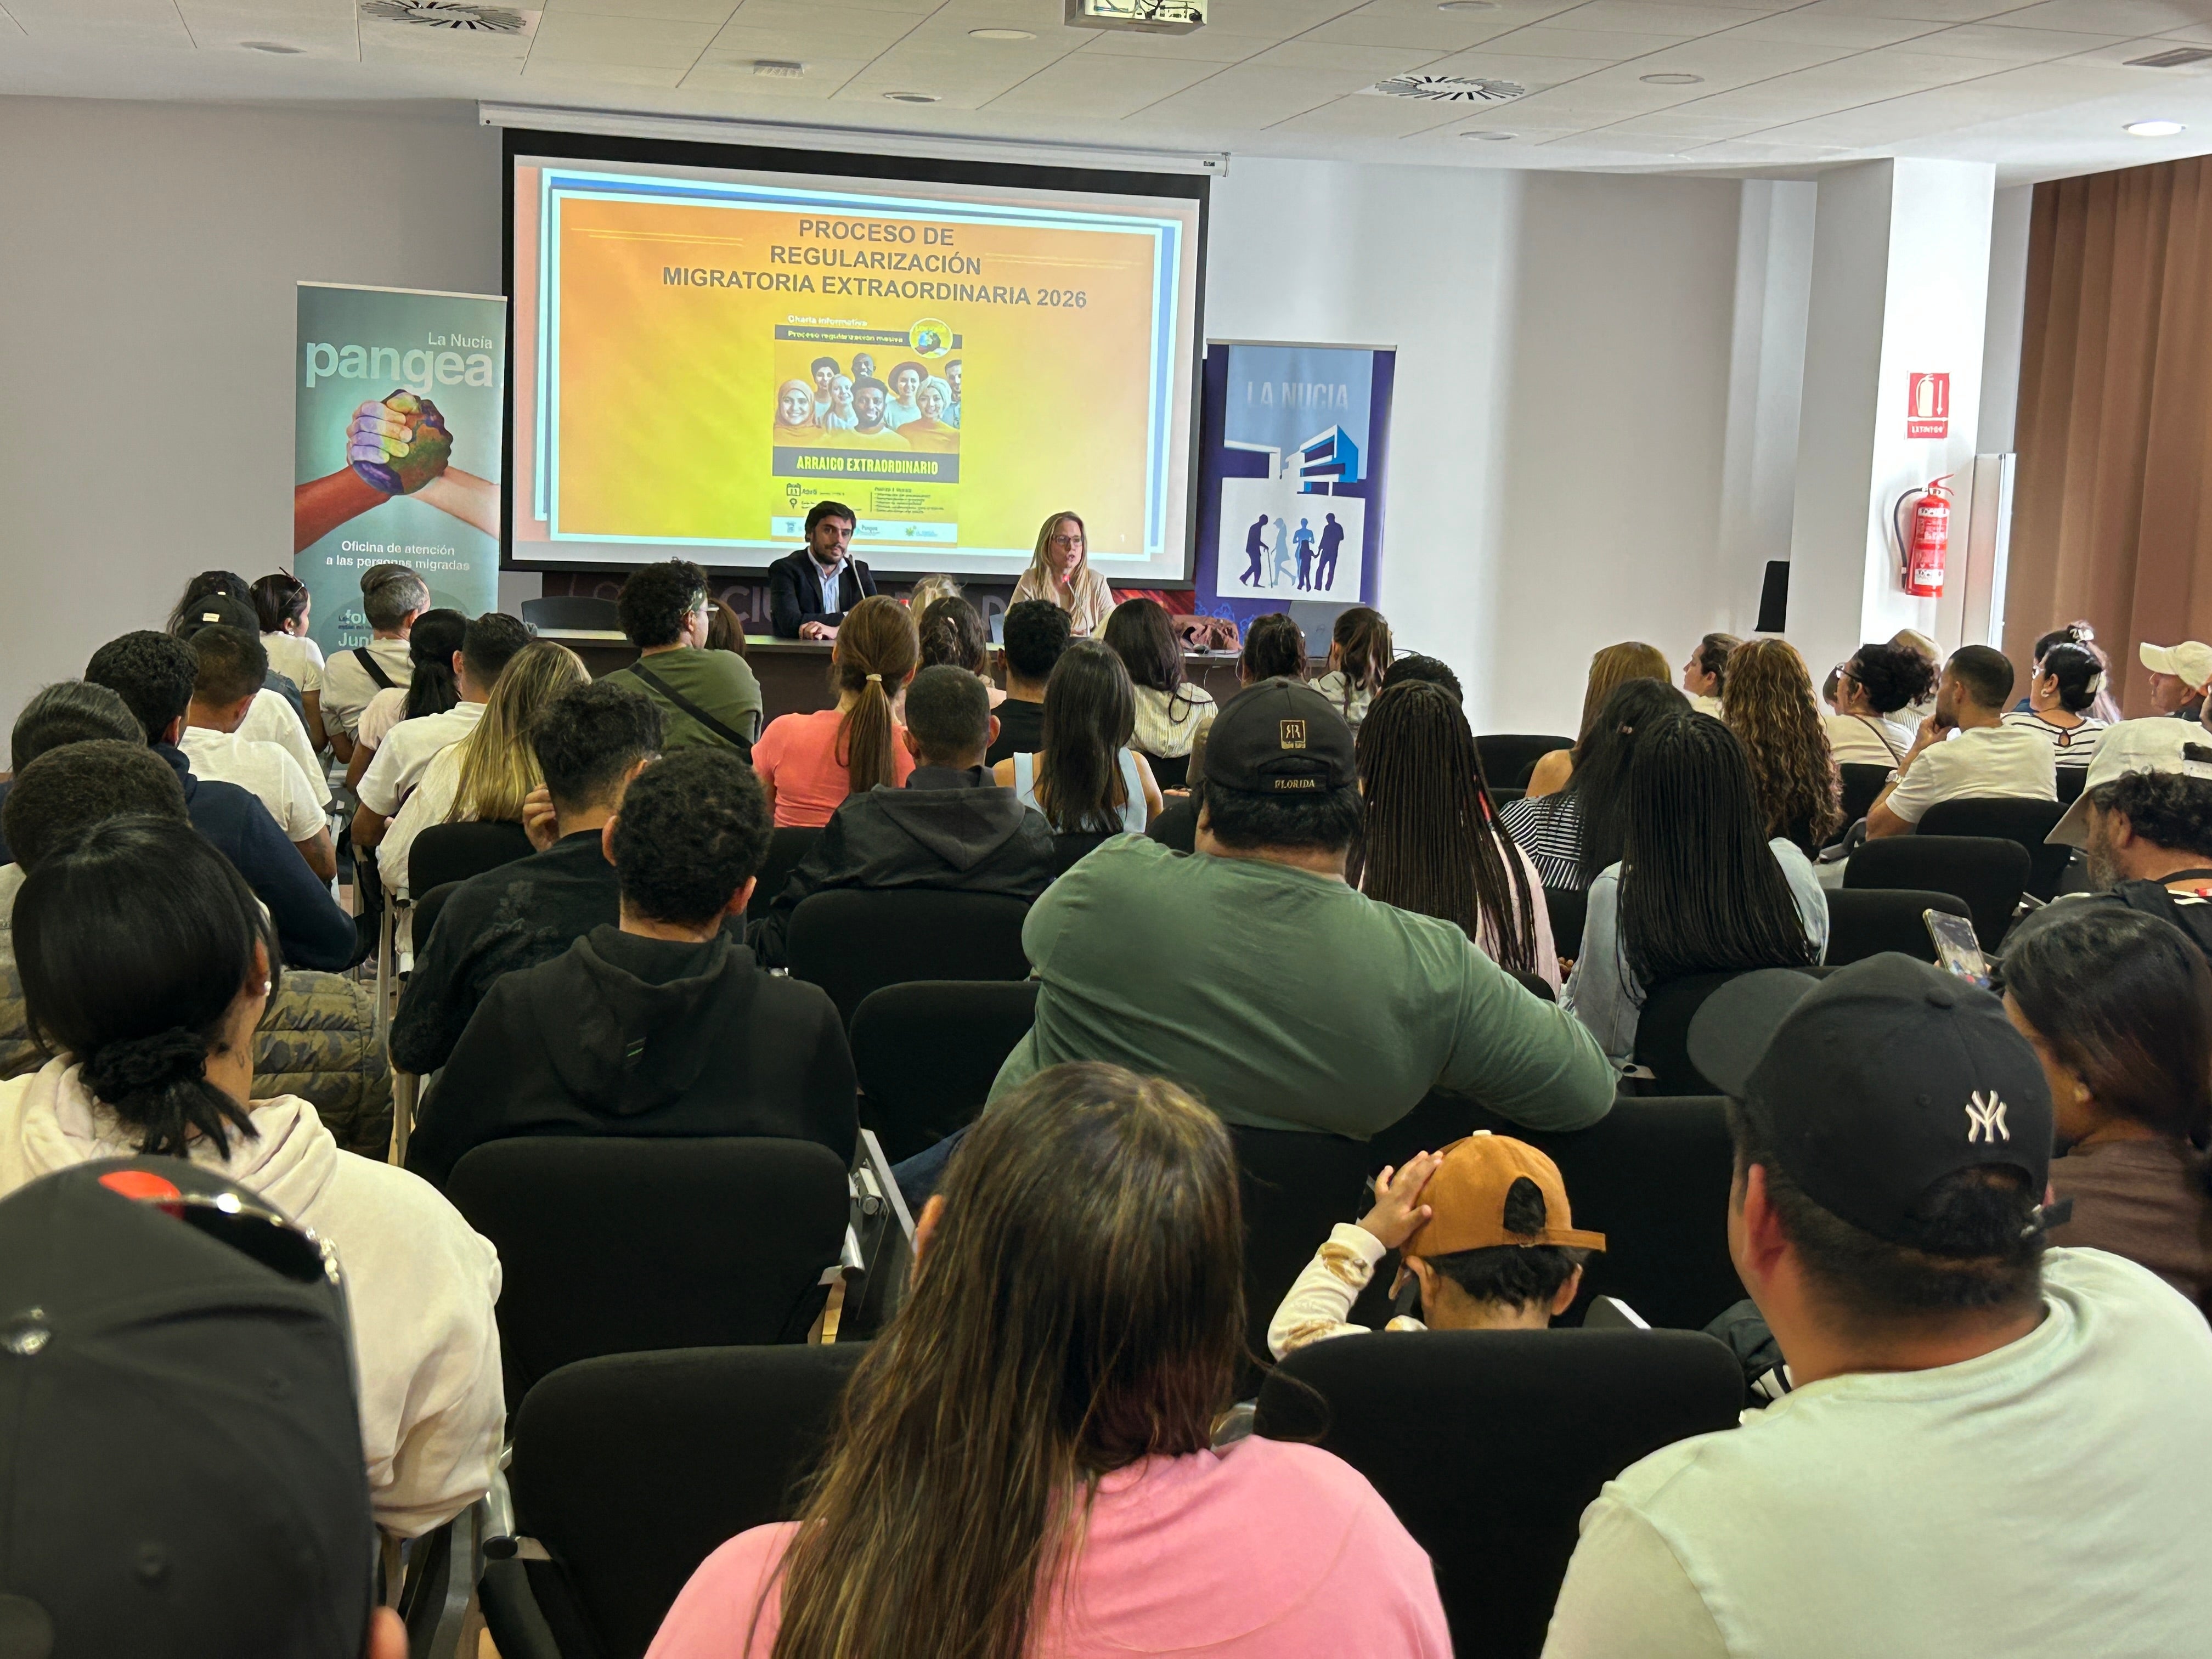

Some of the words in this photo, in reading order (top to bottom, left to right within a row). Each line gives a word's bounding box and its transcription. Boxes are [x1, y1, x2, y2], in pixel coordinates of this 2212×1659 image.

[799, 219, 915, 245] PROCESO
[923, 227, 954, 246] DE
[770, 245, 981, 275] REGULARIZACIÓN
[663, 267, 815, 294] MIGRATORIA
[824, 275, 1031, 306] EXTRAORDINARIA
[1036, 289, 1087, 309] 2026
[428, 332, 446, 346] La
[306, 342, 493, 394] pangea
[1247, 382, 1273, 408] LA
[847, 458, 939, 475] EXTRAORDINARIO
[336, 555, 353, 566] las
[342, 540, 383, 553] Oficina
[387, 543, 401, 553] de
[405, 545, 455, 556] atención
[1275, 779, 1315, 789] FLORIDA
[1965, 1090, 2010, 1143] NY
